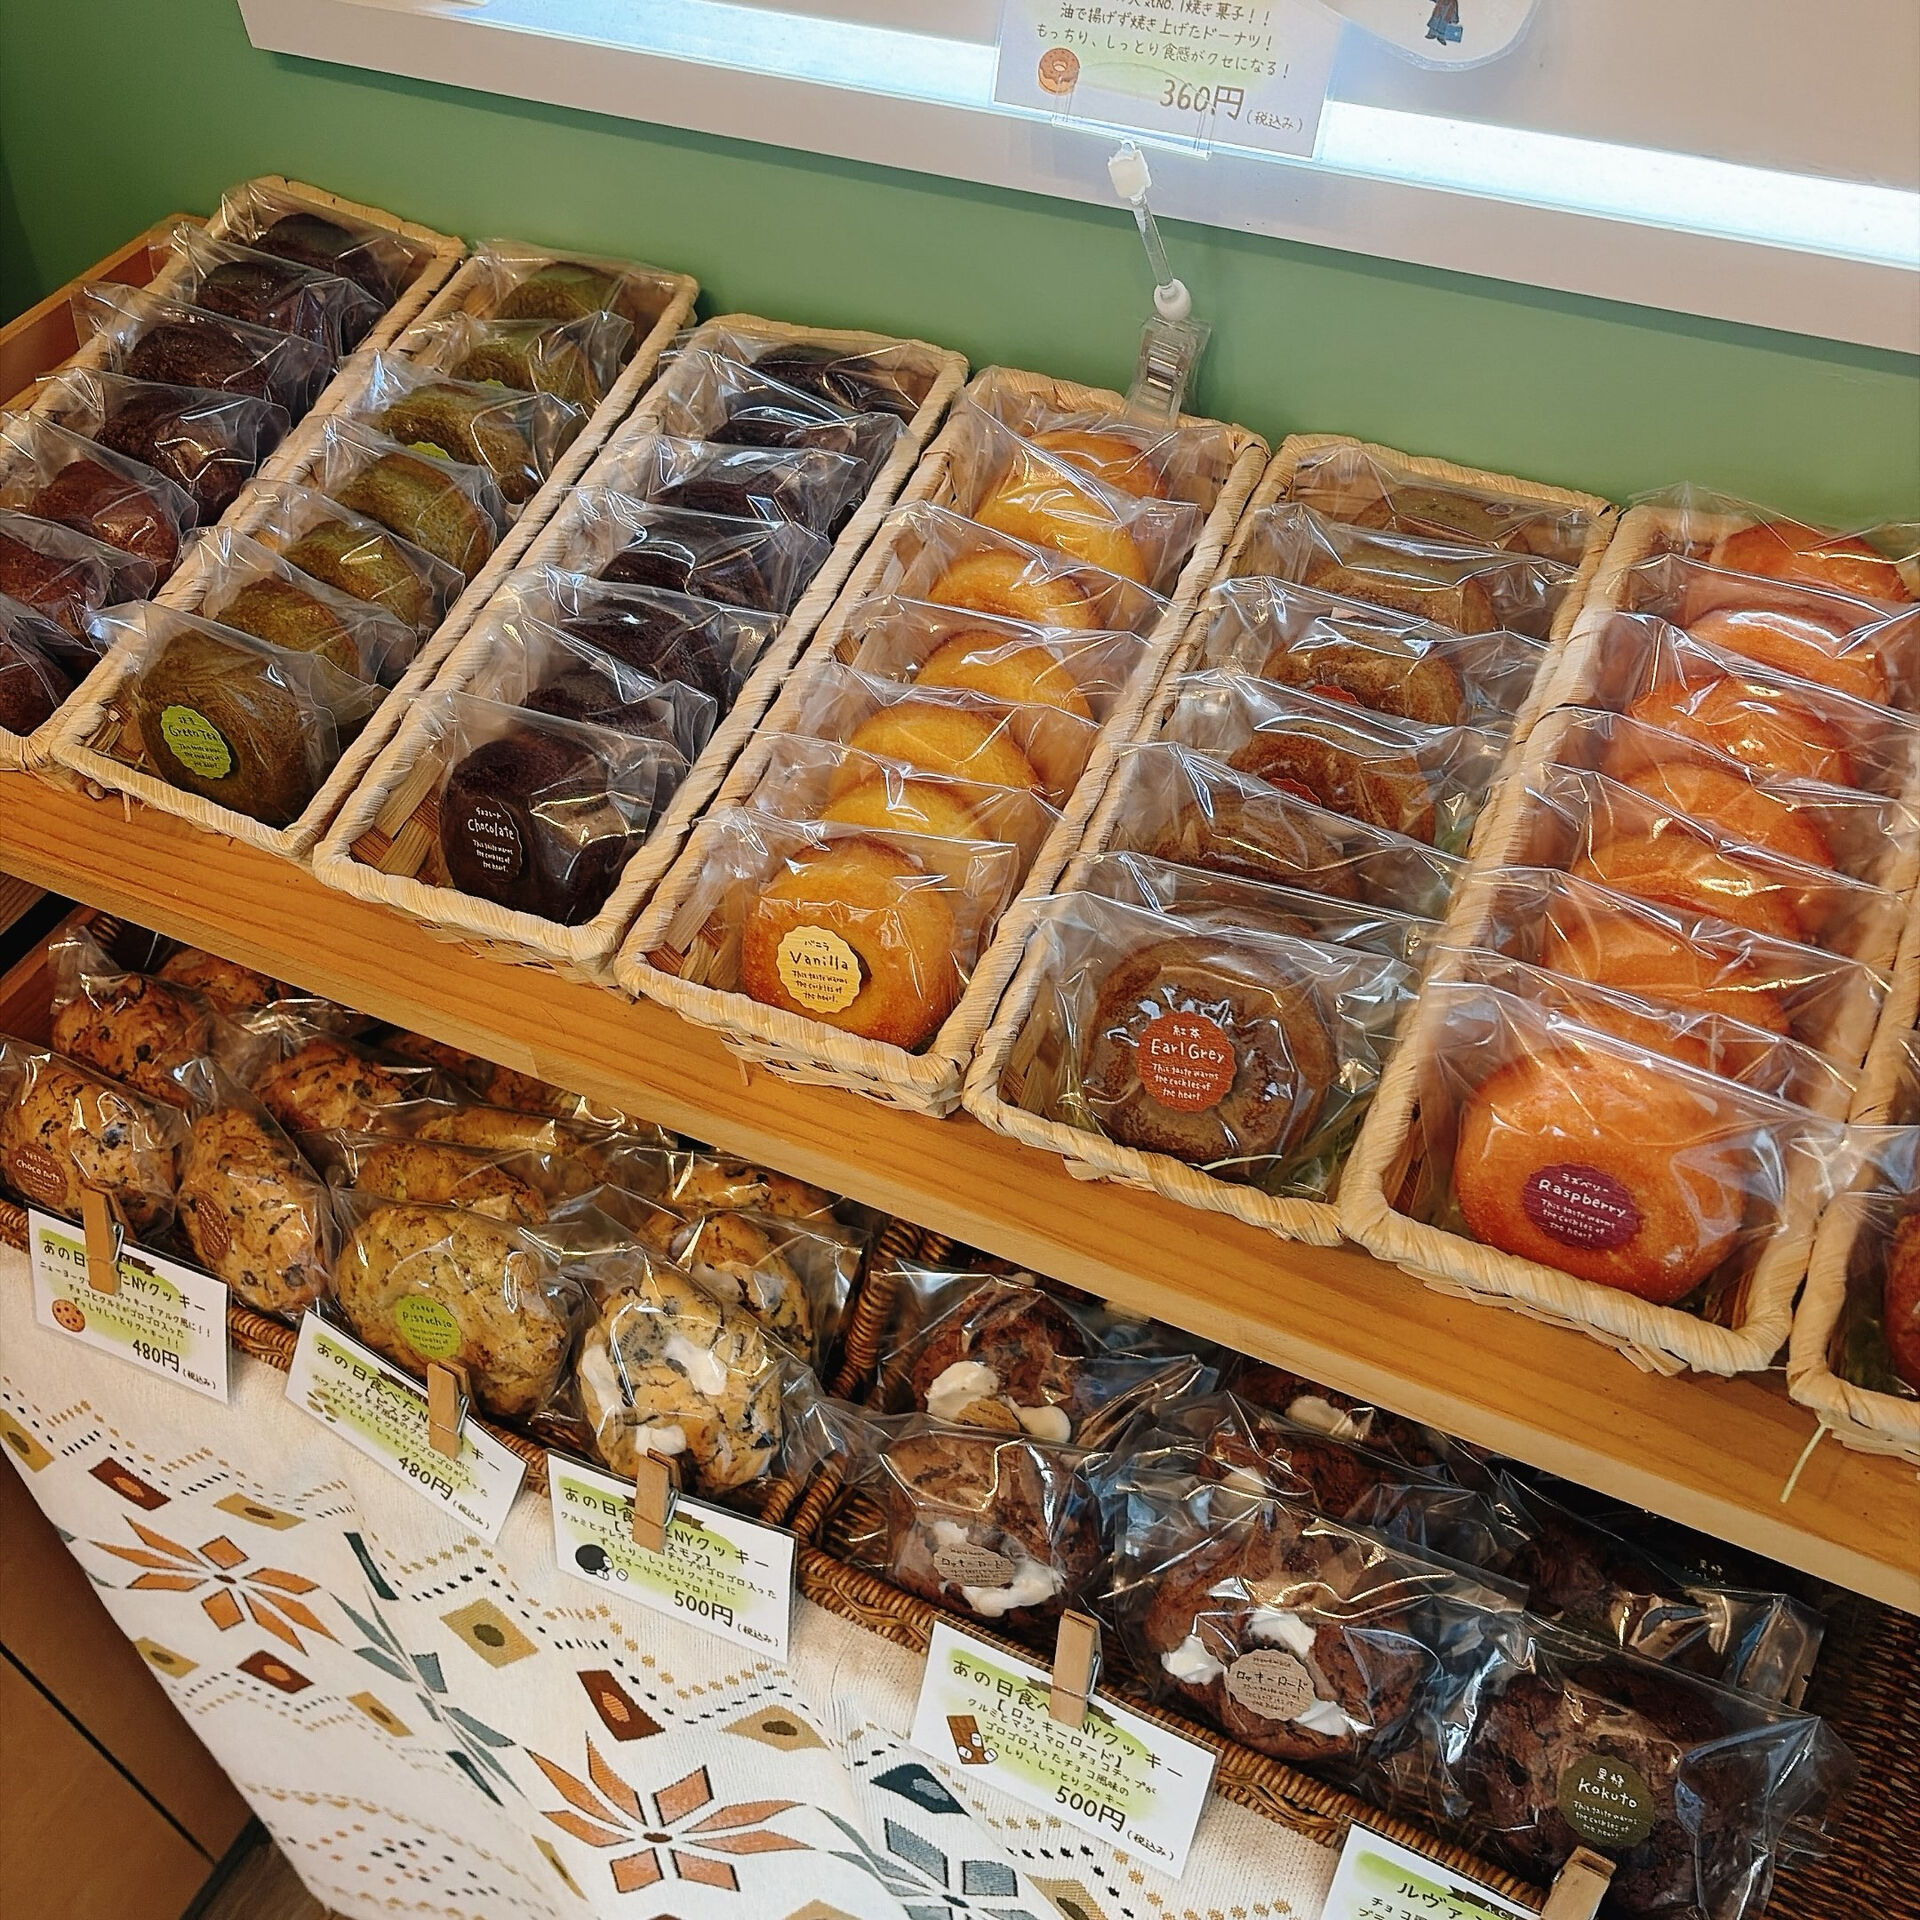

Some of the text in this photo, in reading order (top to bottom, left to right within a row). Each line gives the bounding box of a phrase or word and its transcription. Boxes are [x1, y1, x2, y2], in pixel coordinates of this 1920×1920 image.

[1160, 79, 1245, 120] 360円
[467, 818, 514, 840] Chocolate
[804, 940, 829, 951] バニラ
[789, 950, 848, 970] Vanilla
[1172, 1024, 1202, 1039] 紅茶
[1151, 1038, 1225, 1064] Earl Grey
[1152, 1063, 1219, 1080] This taste warms
[1154, 1074, 1168, 1084] the
[1562, 1173, 1609, 1193] ラズベリー
[1538, 1178, 1626, 1217] Raspberry
[132, 1339, 180, 1373] 480円
[398, 1456, 453, 1500] 480円
[674, 1590, 733, 1627] 500円
[1236, 1670, 1308, 1693] ロッキーロード
[1597, 1767, 1625, 1788] 黒糖
[1578, 1777, 1638, 1808] Kokuto
[1055, 1785, 1126, 1832] 500円
